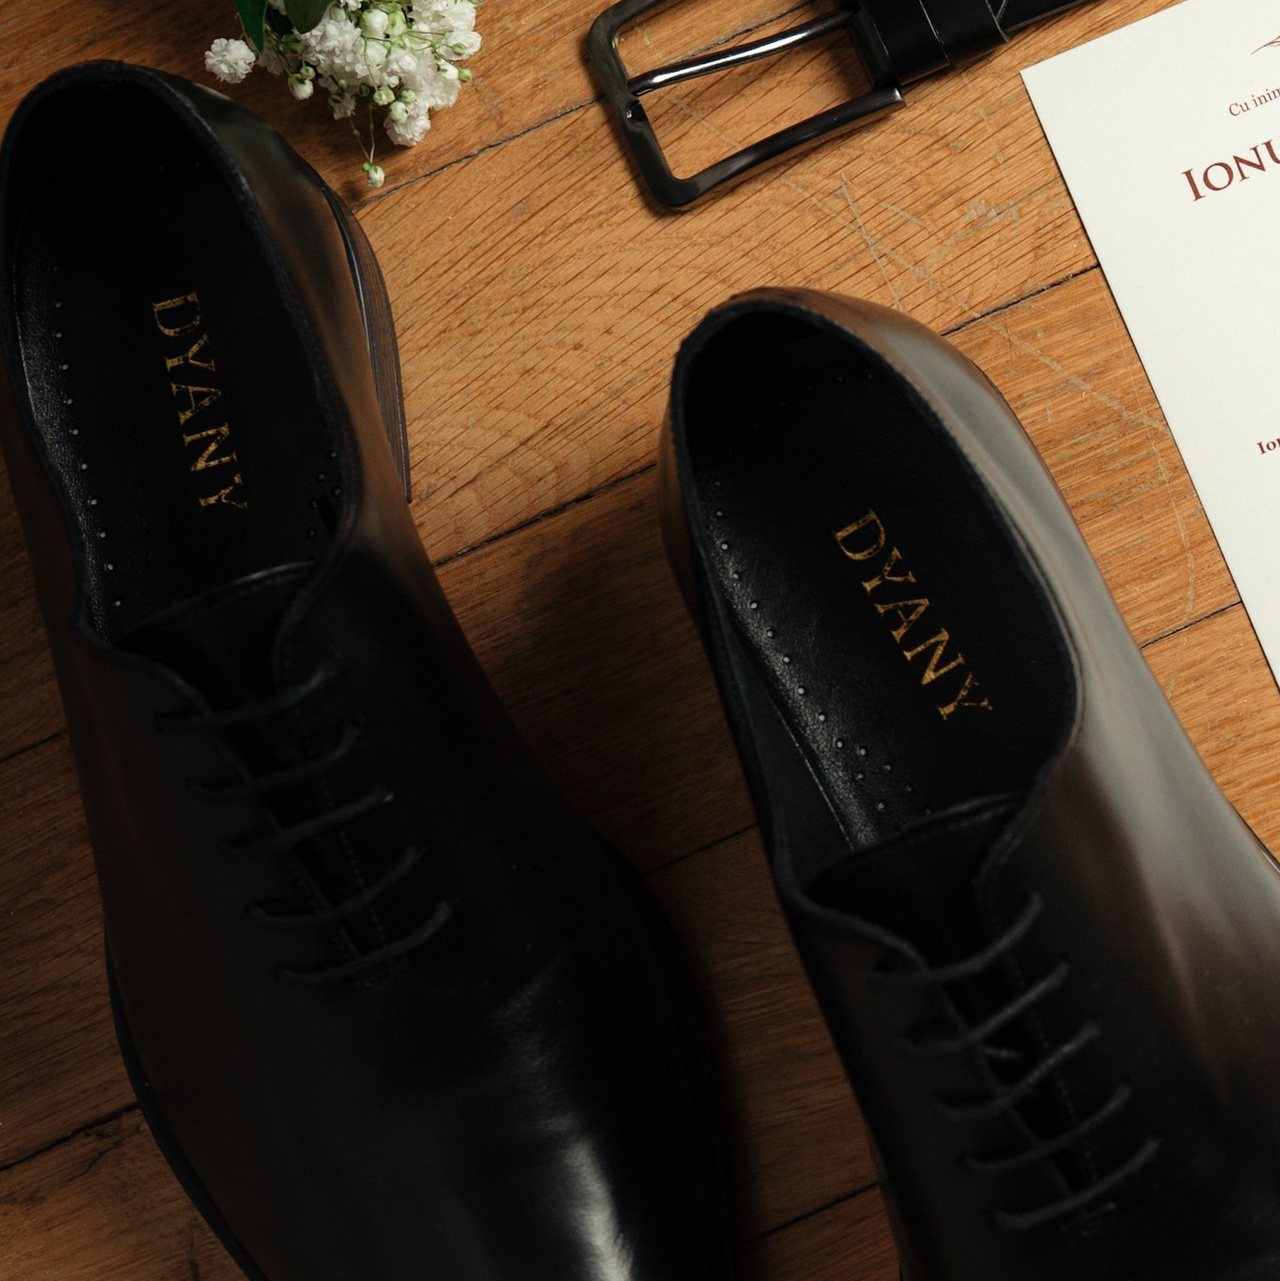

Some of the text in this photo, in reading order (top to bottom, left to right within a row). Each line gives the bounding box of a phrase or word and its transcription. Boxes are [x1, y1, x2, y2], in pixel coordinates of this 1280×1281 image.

[1228, 101, 1250, 117] Cu
[153, 290, 248, 513] DYANY
[833, 508, 994, 720] DYANY
